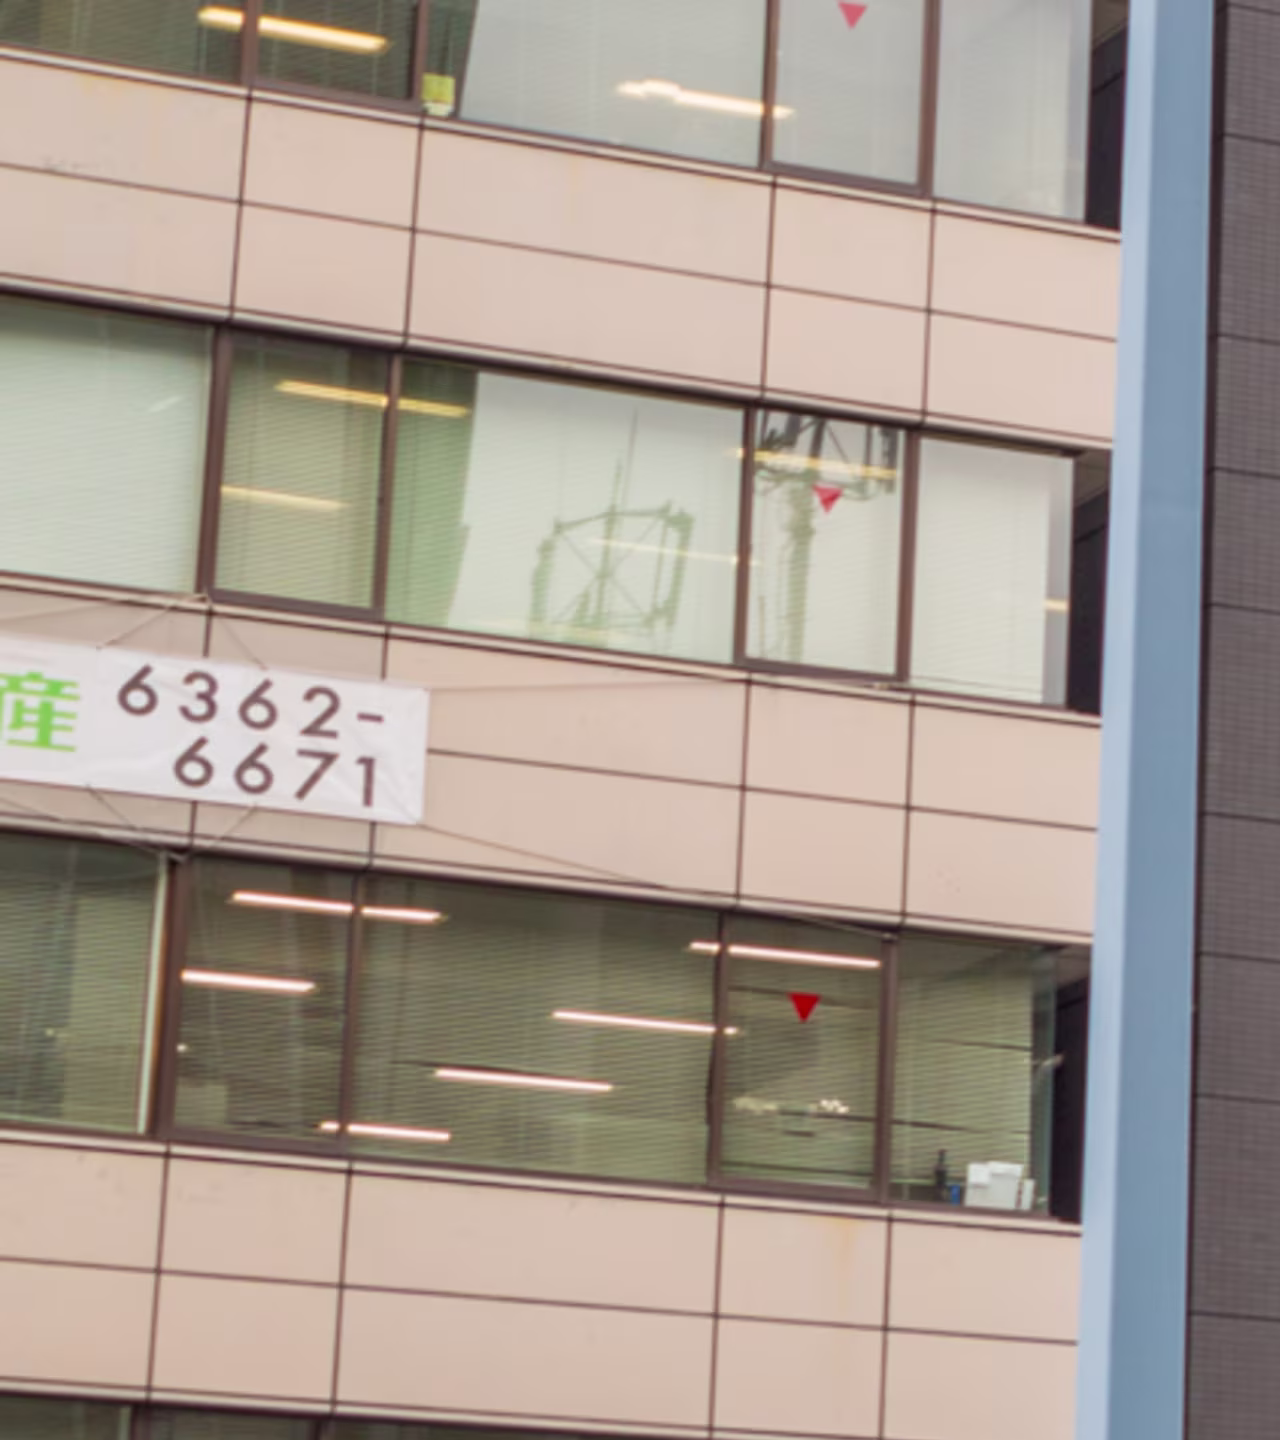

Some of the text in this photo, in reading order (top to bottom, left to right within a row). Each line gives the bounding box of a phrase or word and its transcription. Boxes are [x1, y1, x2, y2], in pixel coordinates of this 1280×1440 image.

[0, 669, 81, 753] 産
[117, 664, 384, 739] 6362-
[173, 736, 377, 808] 6671
